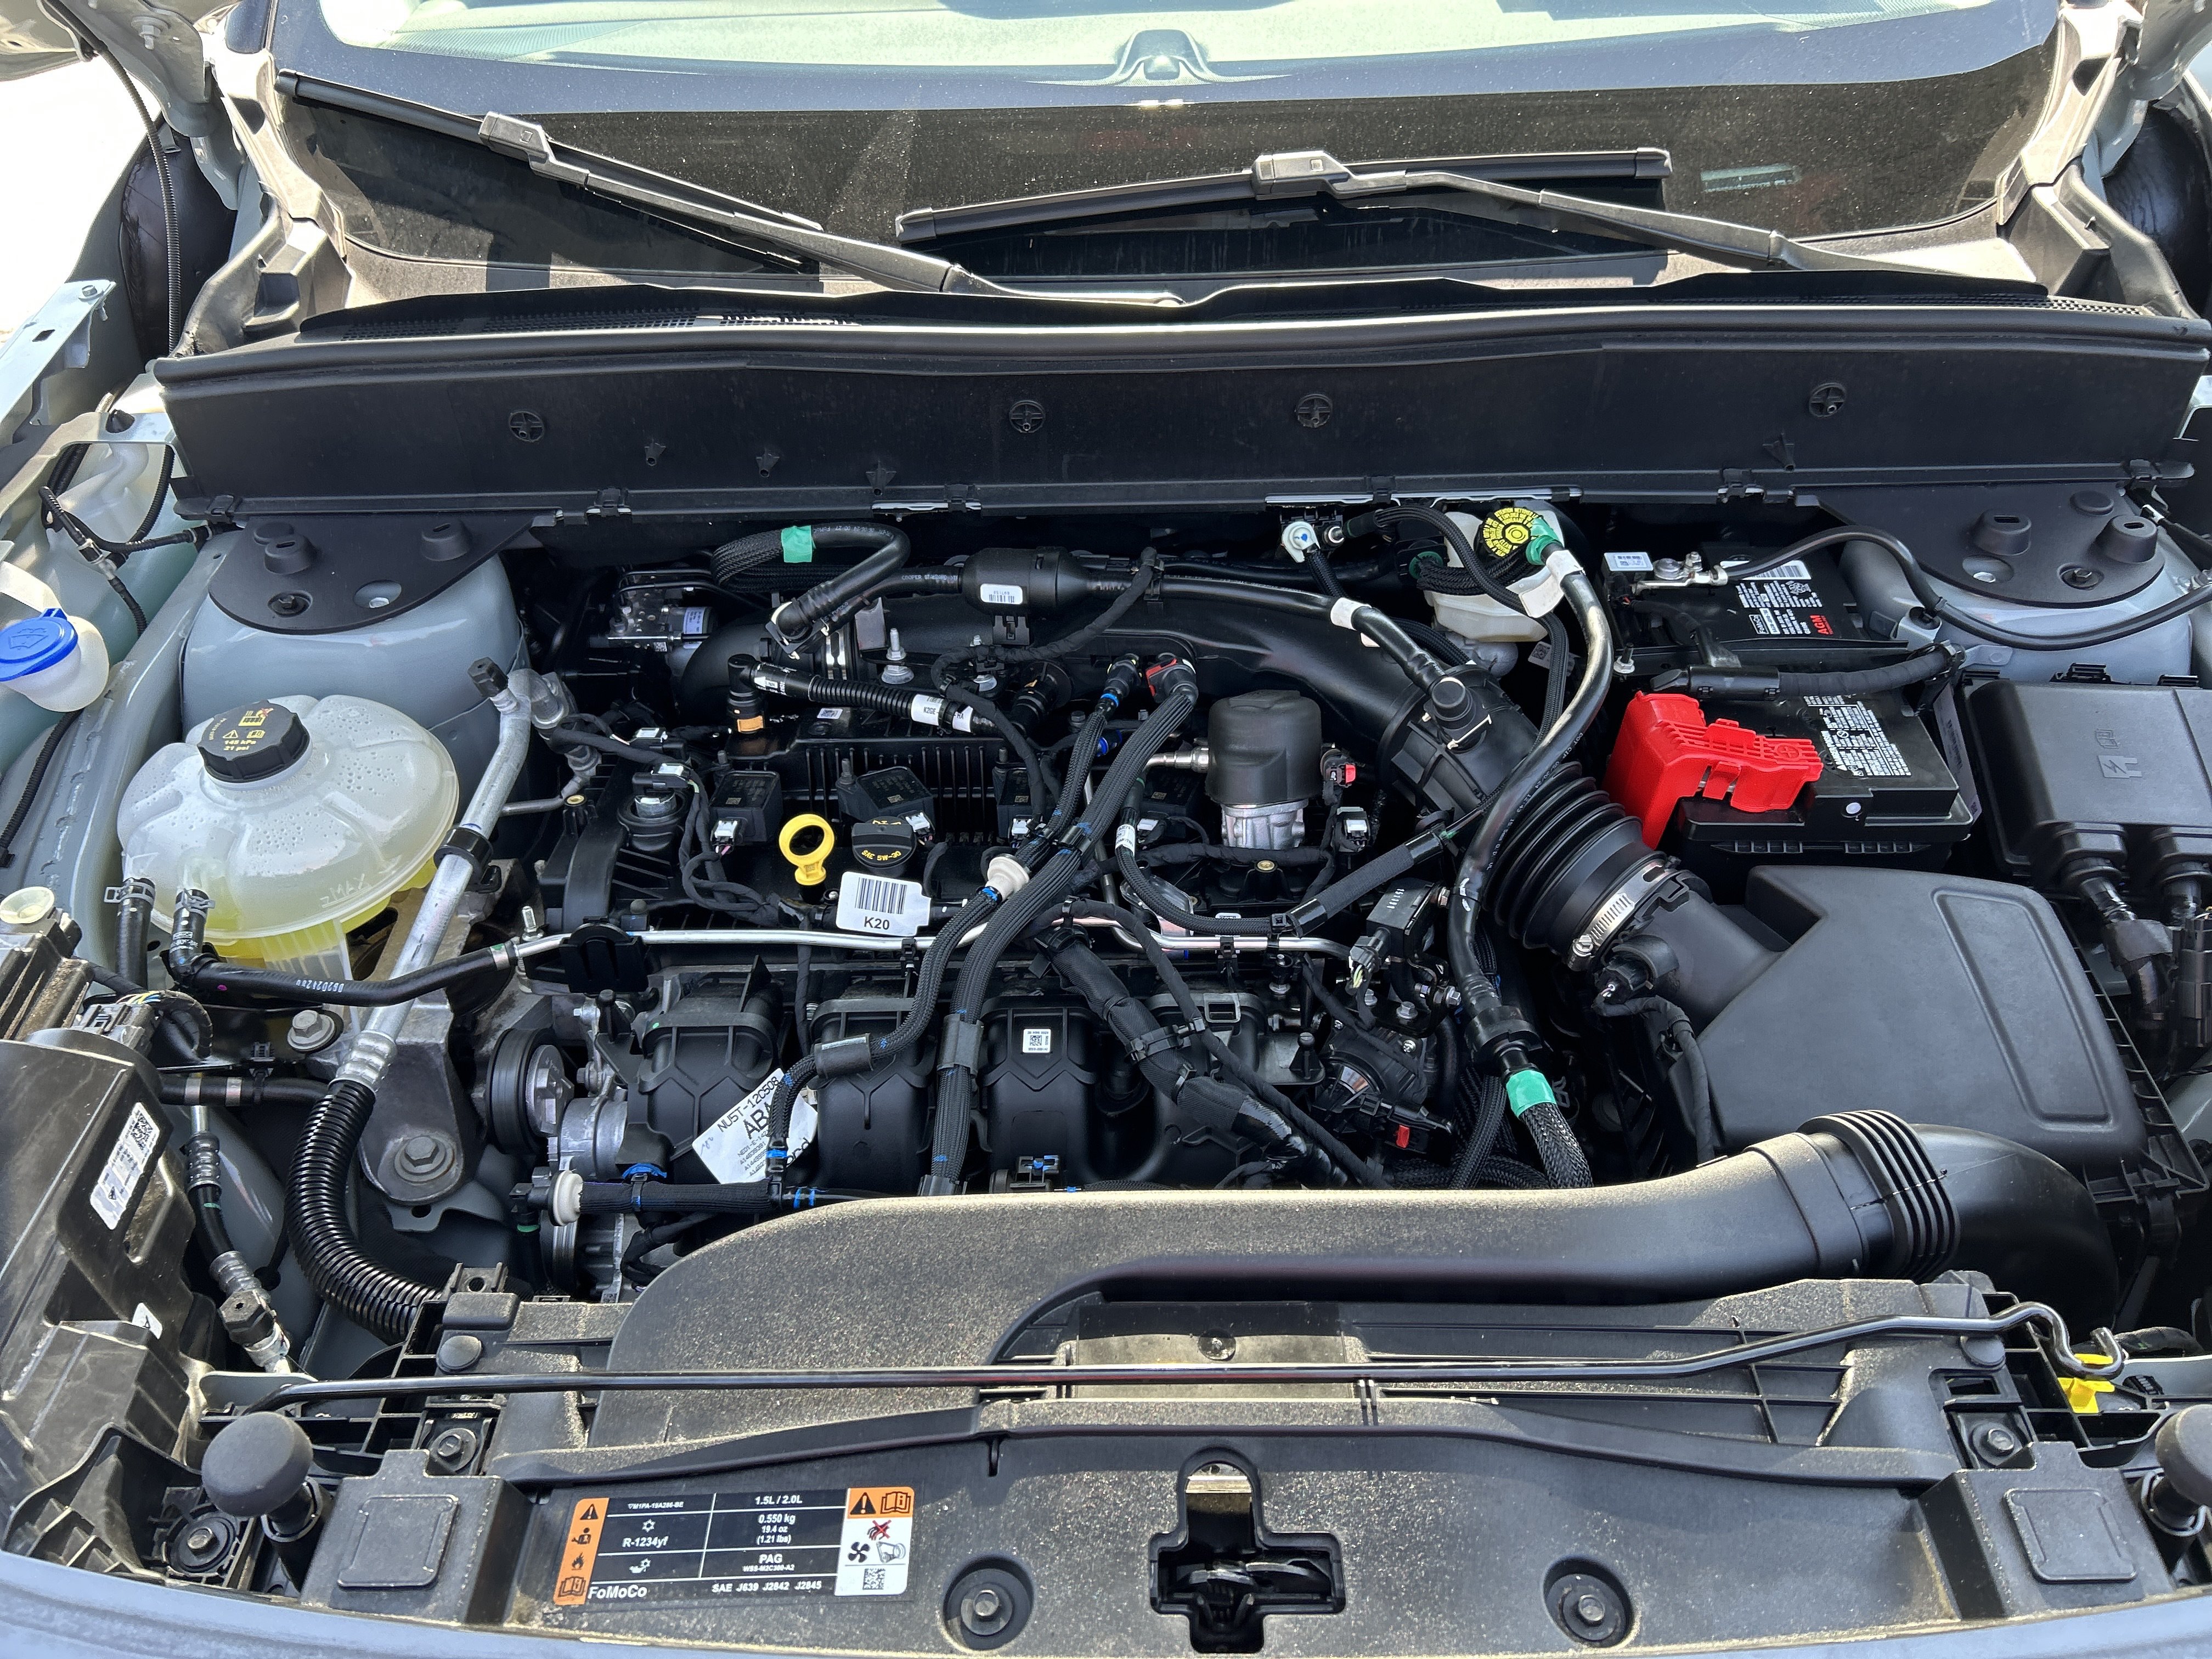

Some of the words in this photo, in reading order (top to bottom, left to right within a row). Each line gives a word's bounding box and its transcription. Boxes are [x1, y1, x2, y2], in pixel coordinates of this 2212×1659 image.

[1810, 615, 1829, 635] AGM
[861, 850, 876, 860] SAE
[877, 851, 901, 861] 5W-30
[864, 916, 890, 930] K20
[716, 1076, 779, 1133] NU5T-12C508
[755, 1496, 775, 1505] 1.5L
[782, 1494, 803, 1504] 2.0L
[758, 1514, 782, 1523] 0.550
[784, 1513, 795, 1525] kg
[622, 1536, 669, 1548] R-1234yf
[757, 1535, 775, 1545] (1.21
[776, 1534, 791, 1544] lbs)
[759, 1554, 783, 1564] PAG
[588, 1584, 647, 1599] FoMoCo
[712, 1583, 733, 1592] SAE
[736, 1583, 759, 1591] J639
[762, 1582, 790, 1591] J2842
[794, 1581, 822, 1590] J2845
